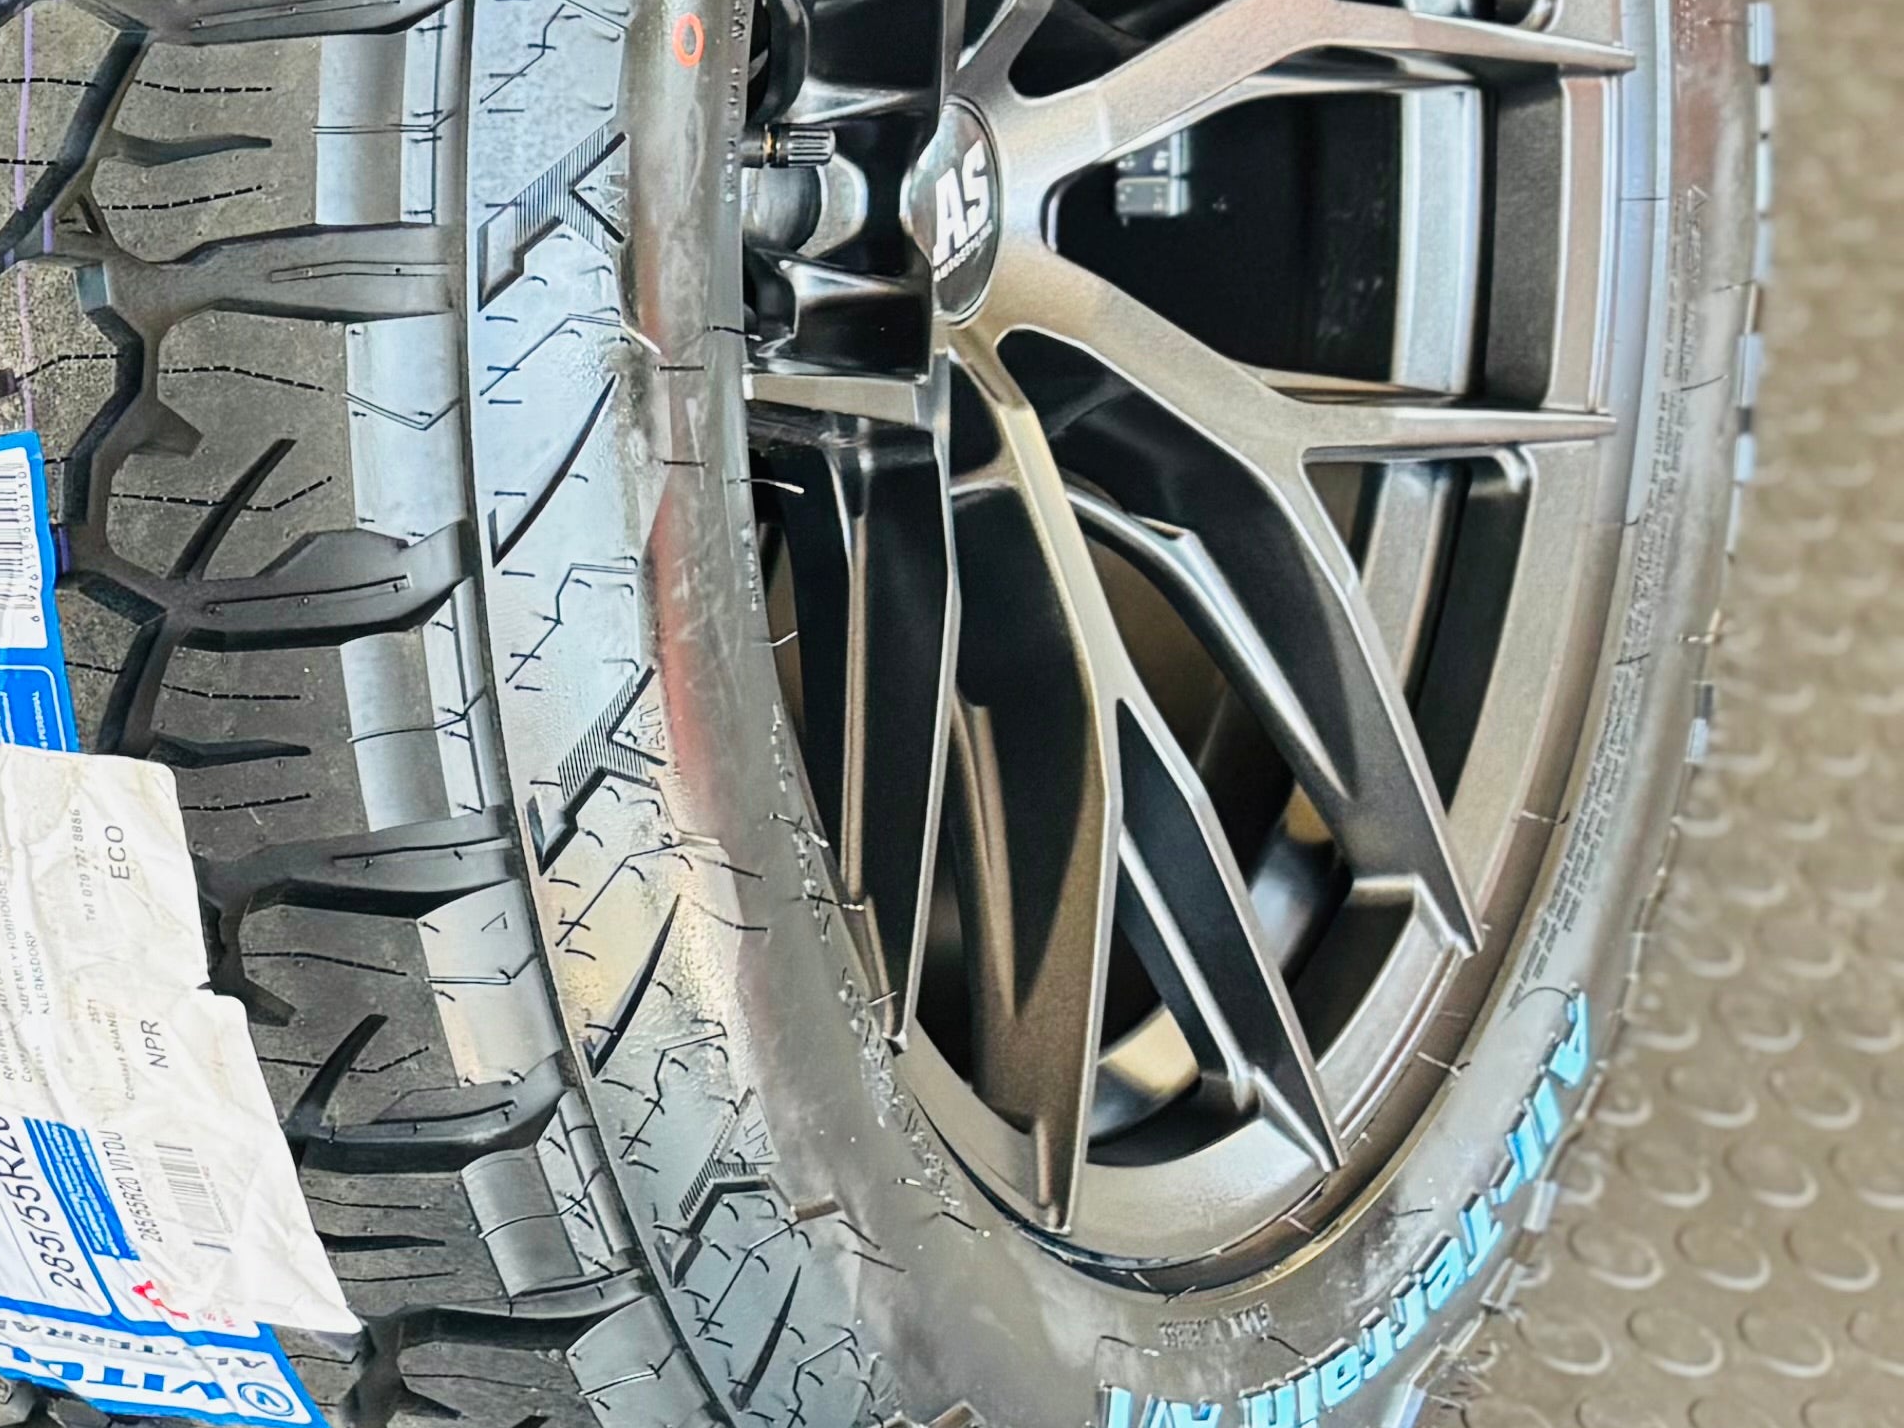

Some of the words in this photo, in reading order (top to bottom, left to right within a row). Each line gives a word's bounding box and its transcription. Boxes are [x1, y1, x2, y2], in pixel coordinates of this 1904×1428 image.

[932, 139, 990, 268] AS
[102, 824, 132, 879] ECO
[138, 1018, 169, 1068] NPR
